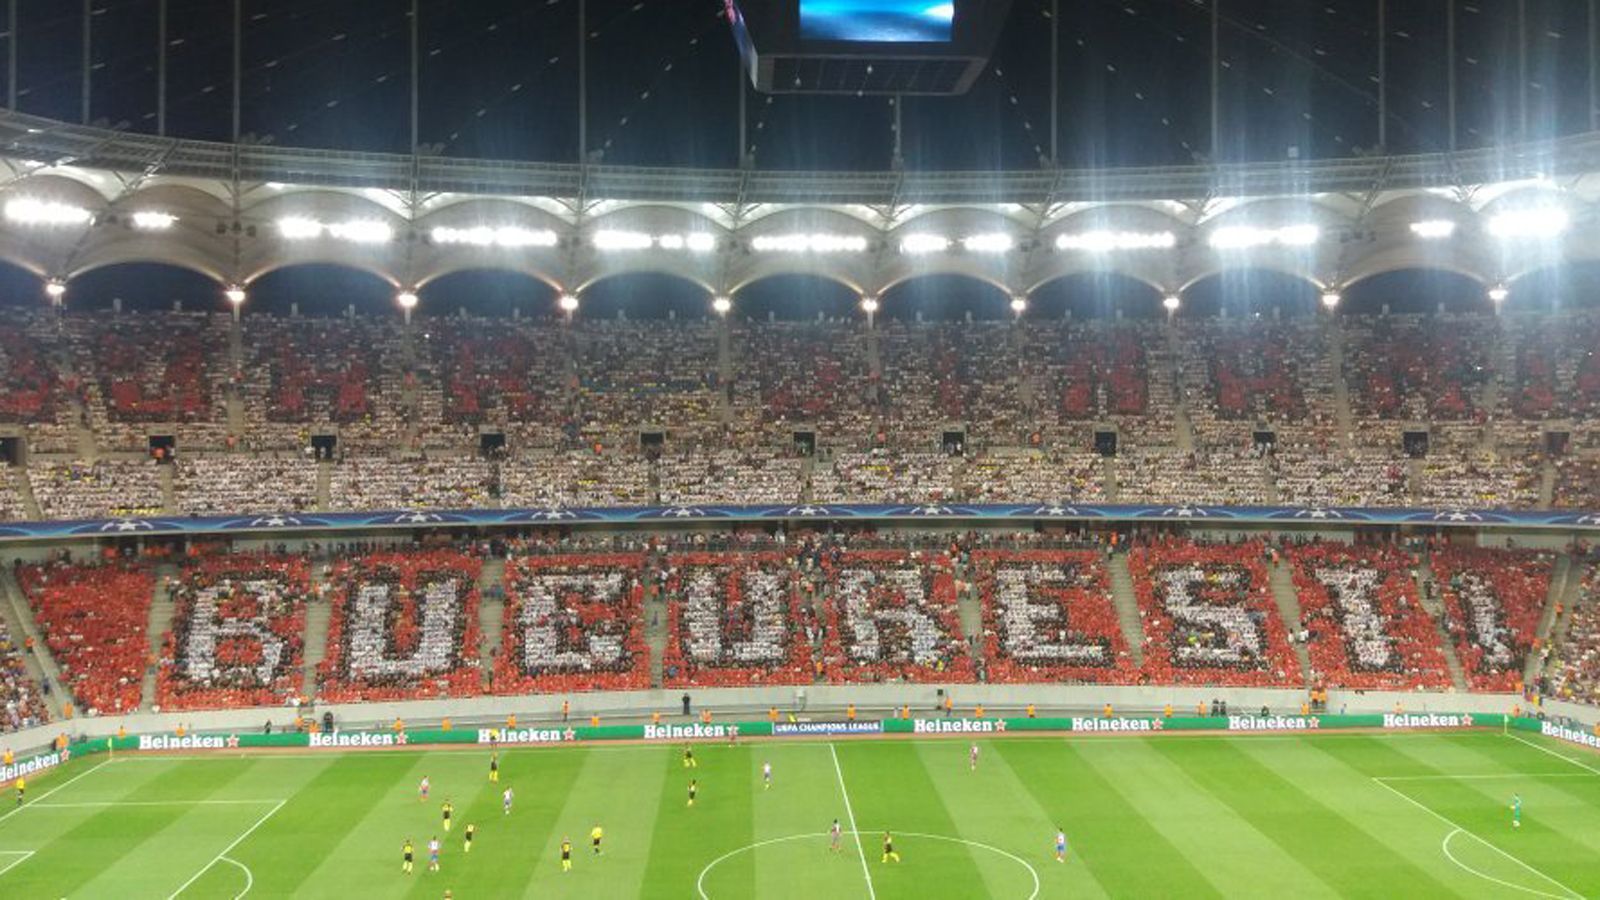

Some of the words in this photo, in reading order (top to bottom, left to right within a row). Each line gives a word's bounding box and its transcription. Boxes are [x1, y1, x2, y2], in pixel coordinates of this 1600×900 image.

[775, 724, 798, 732] UEFA
[848, 721, 879, 731] LEAGUE
[914, 718, 993, 733] Heineken
[1072, 716, 1151, 732] Heineken
[1228, 714, 1306, 730] Heineken
[1383, 712, 1460, 728] Heineken
[309, 731, 394, 748] Heineken
[643, 724, 725, 740] Heineken
[138, 734, 225, 750] Heineken
